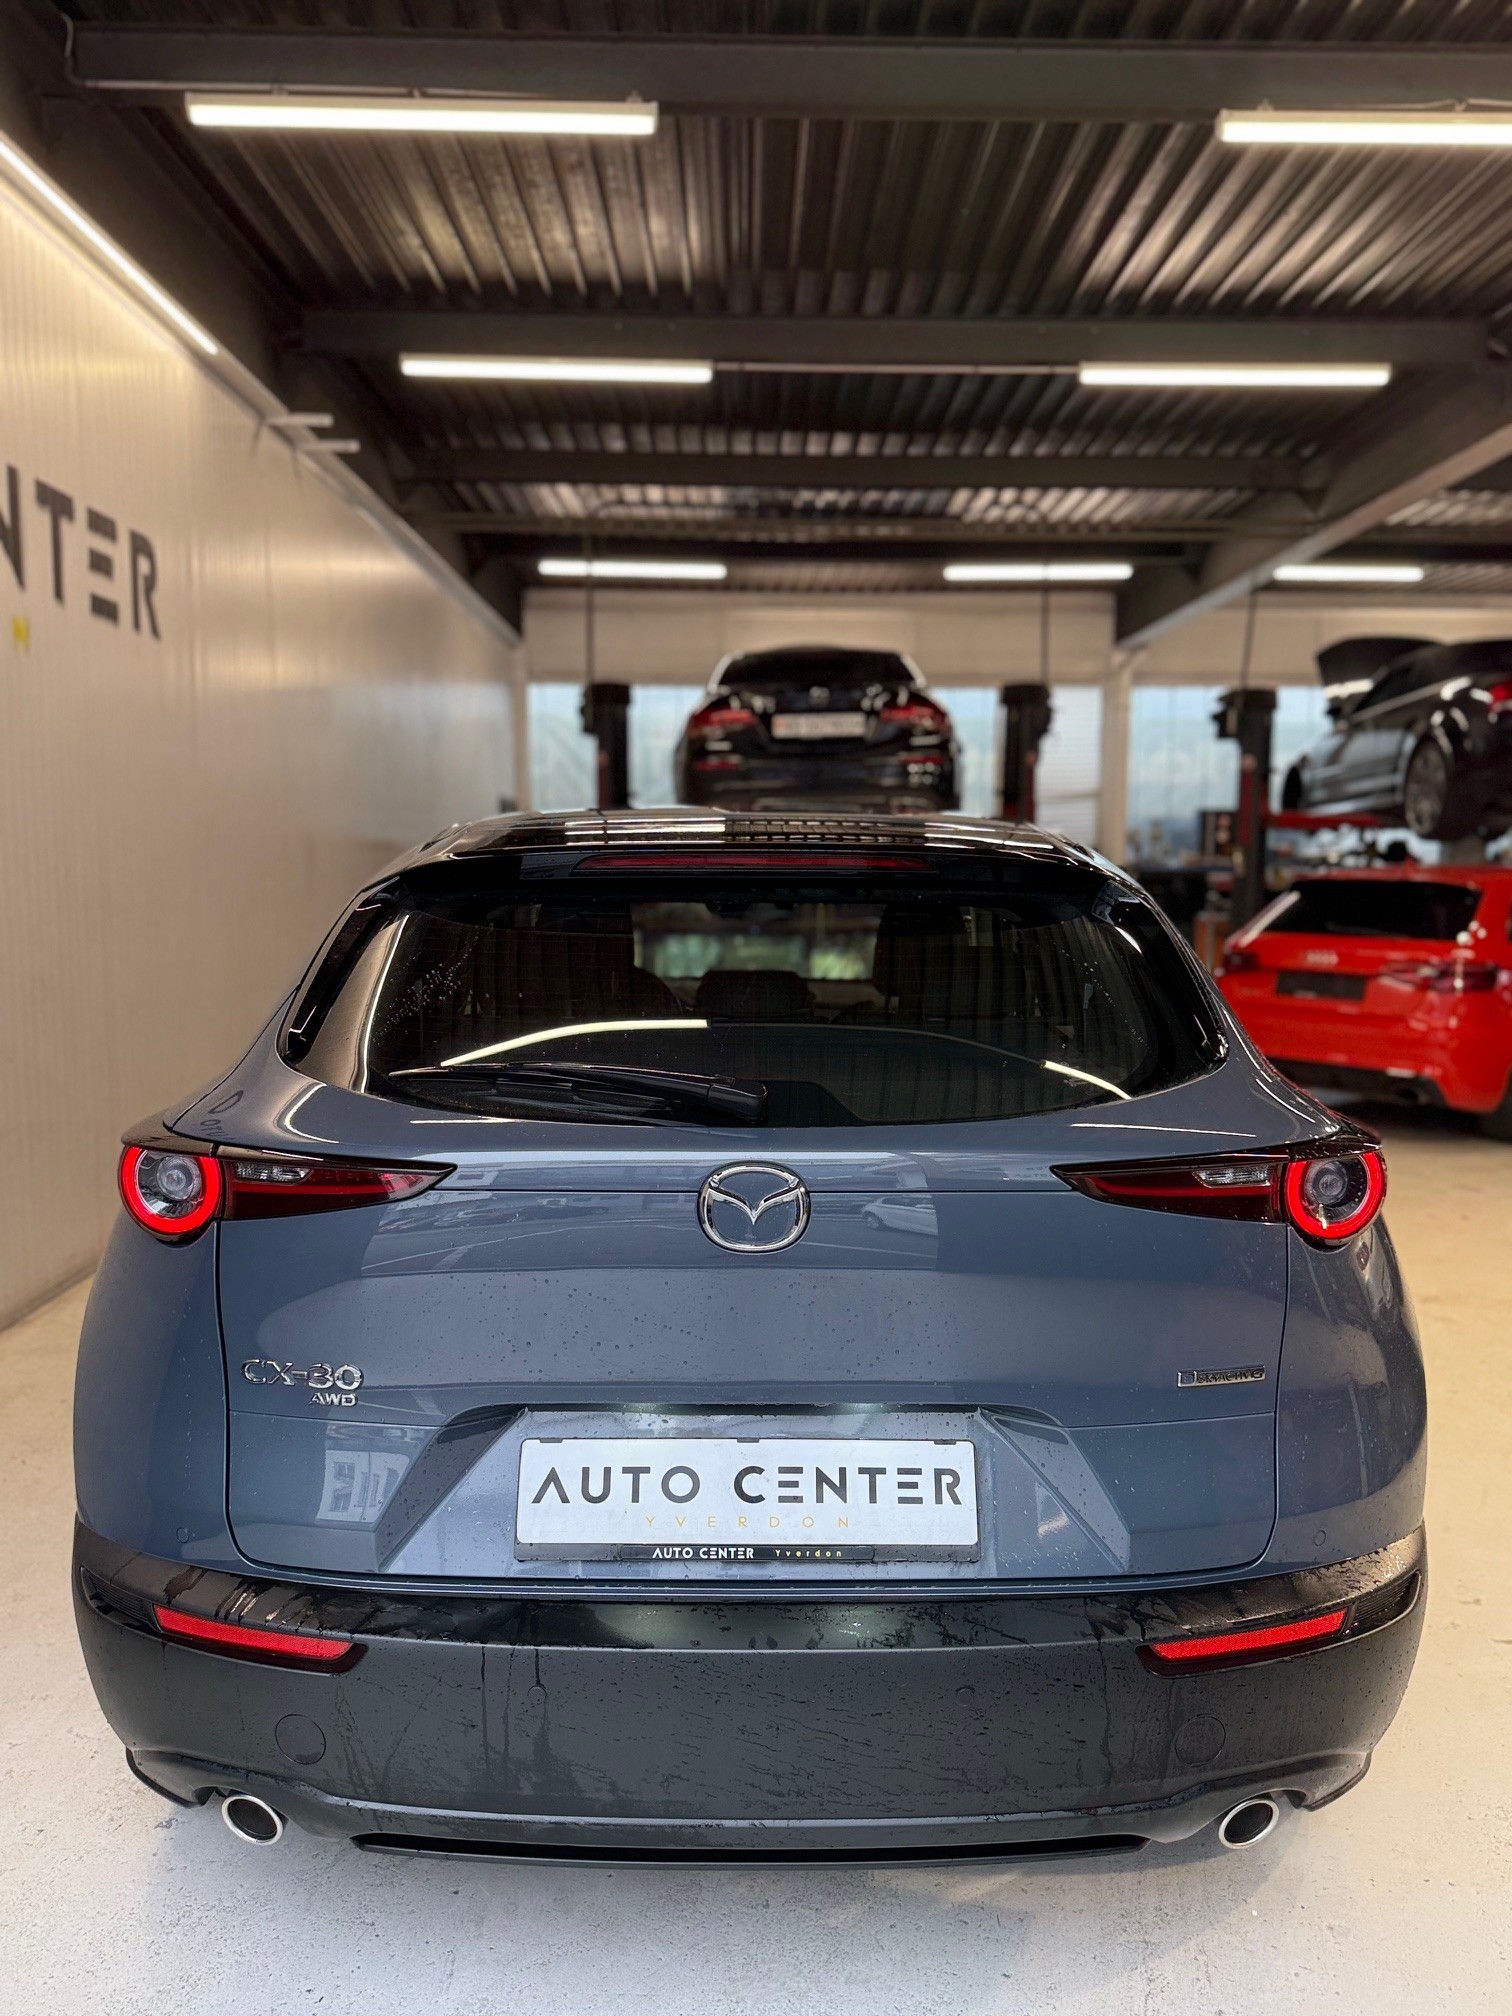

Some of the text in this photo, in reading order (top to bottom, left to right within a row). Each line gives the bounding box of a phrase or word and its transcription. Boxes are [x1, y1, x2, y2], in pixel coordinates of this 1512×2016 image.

[240, 1358, 363, 1391] CX-30
[309, 1392, 358, 1407] AWD
[532, 1466, 963, 1505] AUTO CENTER
[645, 1515, 849, 1529] YVERDON
[652, 1547, 843, 1559] AUTO CENTER Yverdon
